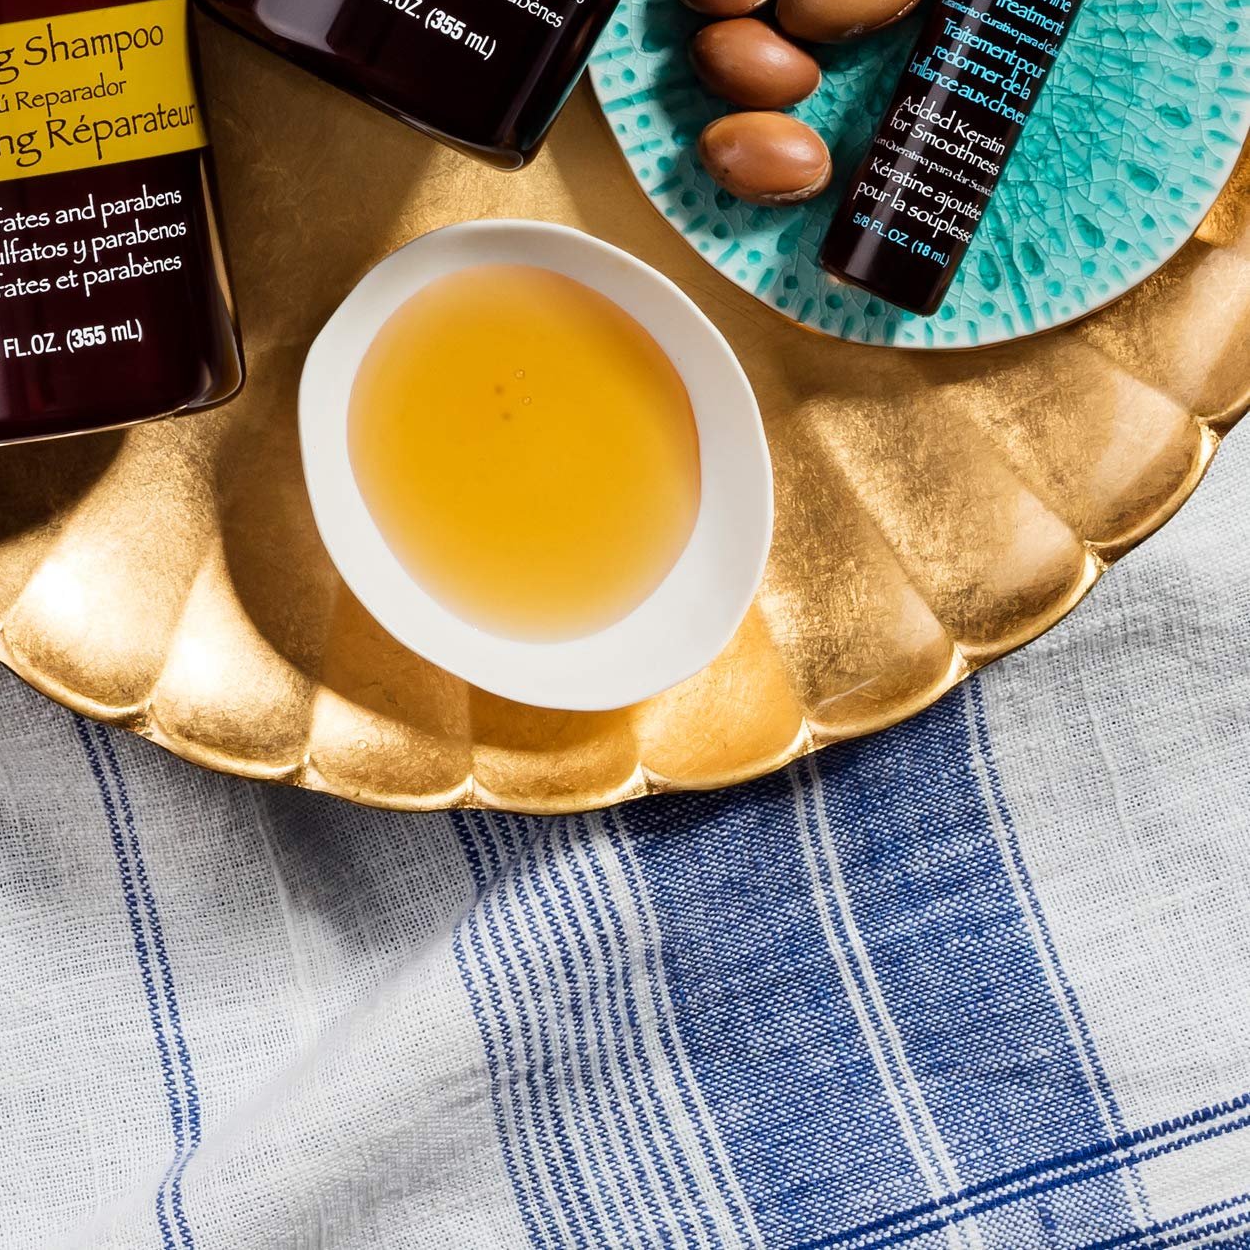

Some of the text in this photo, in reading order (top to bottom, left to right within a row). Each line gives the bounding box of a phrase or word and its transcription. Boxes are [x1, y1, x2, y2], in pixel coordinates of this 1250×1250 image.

[24, 23, 163, 70] Shampoo
[425, 8, 466, 39] (355
[465, 32, 496, 60] mL)
[943, 17, 1046, 79] Traitement pour
[979, 12, 1020, 38] Curativo
[931, 43, 1004, 84] redonner
[15, 72, 126, 117] Reparador
[957, 84, 990, 108] aux
[46, 103, 194, 160] Réparateur
[889, 108, 1000, 176] for Smoothness
[899, 95, 1006, 156] Added Keratin
[56, 194, 95, 223] and
[101, 184, 181, 228] parabens
[852, 181, 973, 244] pour la souplesse
[869, 156, 934, 198] Kératine
[932, 190, 982, 222] ajoutée
[92, 219, 186, 262] parabenos
[852, 212, 871, 228] 5/8
[911, 239, 932, 257] (18
[930, 251, 950, 269] mL)
[83, 253, 181, 297] parabènes
[67, 325, 106, 353] (355
[111, 319, 142, 342] mL)
